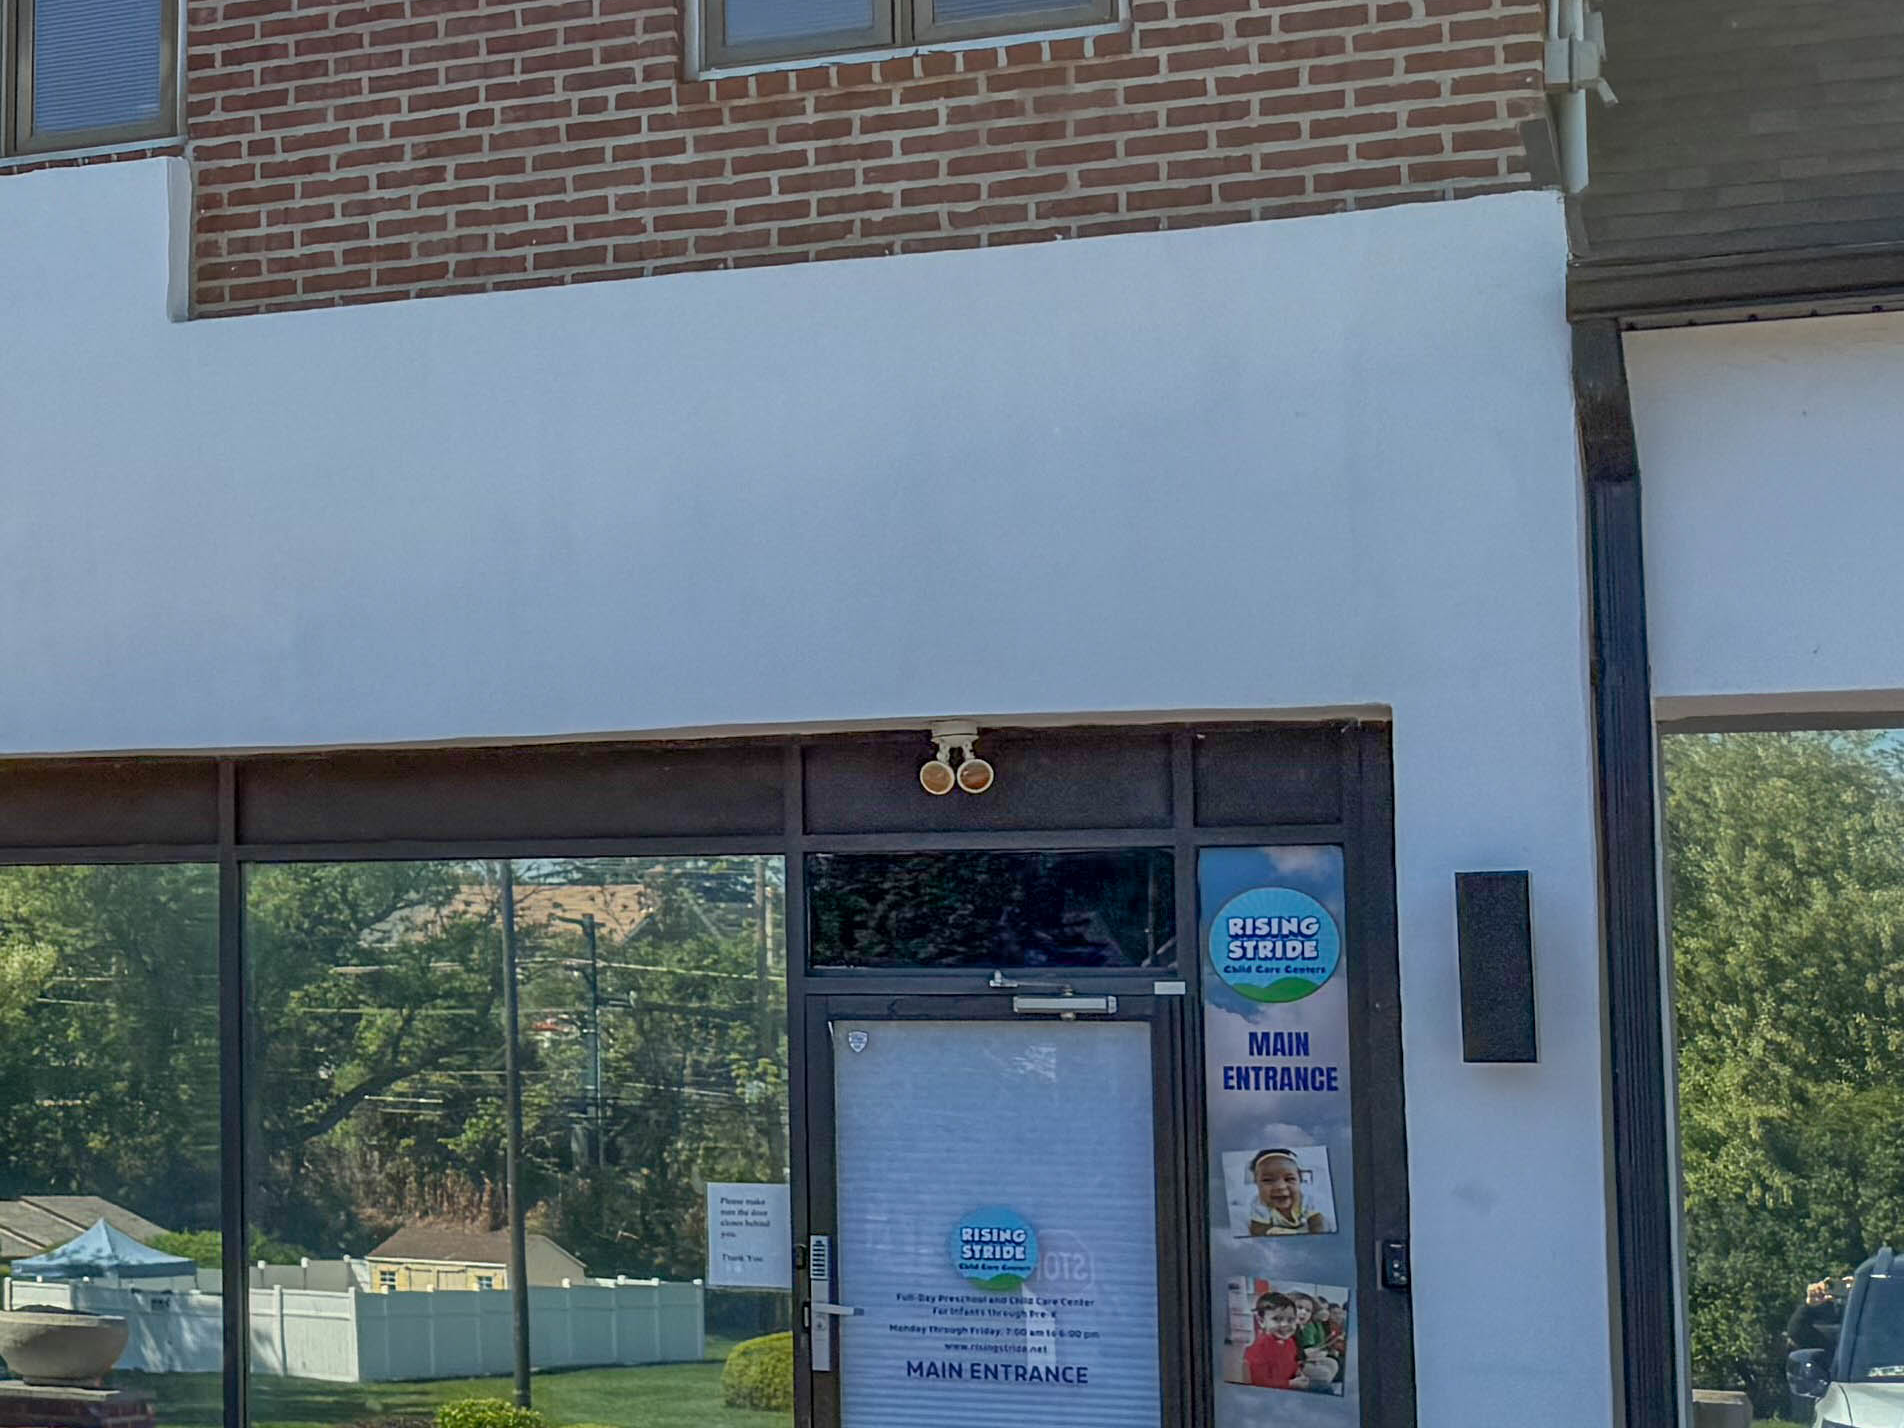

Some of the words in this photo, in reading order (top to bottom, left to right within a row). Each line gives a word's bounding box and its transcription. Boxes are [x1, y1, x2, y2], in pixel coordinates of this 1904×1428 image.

[1227, 916, 1321, 938] RISING
[1227, 939, 1319, 960] STRIDE
[1224, 965, 1252, 974] Child
[1255, 965, 1280, 974] Care
[1248, 1031, 1310, 1056] MAIN
[1223, 1065, 1339, 1091] ENTRANCE
[962, 1227, 1027, 1243] RISING
[961, 1245, 1025, 1260] STRIDE
[938, 1294, 986, 1303] Preschool
[989, 1296, 1007, 1304] and
[1009, 1296, 1033, 1305] Child
[1035, 1297, 1058, 1306] Care
[1060, 1298, 1094, 1307] Center
[933, 1307, 947, 1315] For
[949, 1307, 985, 1317] Infants
[987, 1308, 1026, 1319] through
[889, 1324, 926, 1335] Monday
[944, 1343, 1047, 1354] www.risingstride.net
[906, 1361, 962, 1380] MAIN
[970, 1363, 1088, 1384] ENTRANCE
